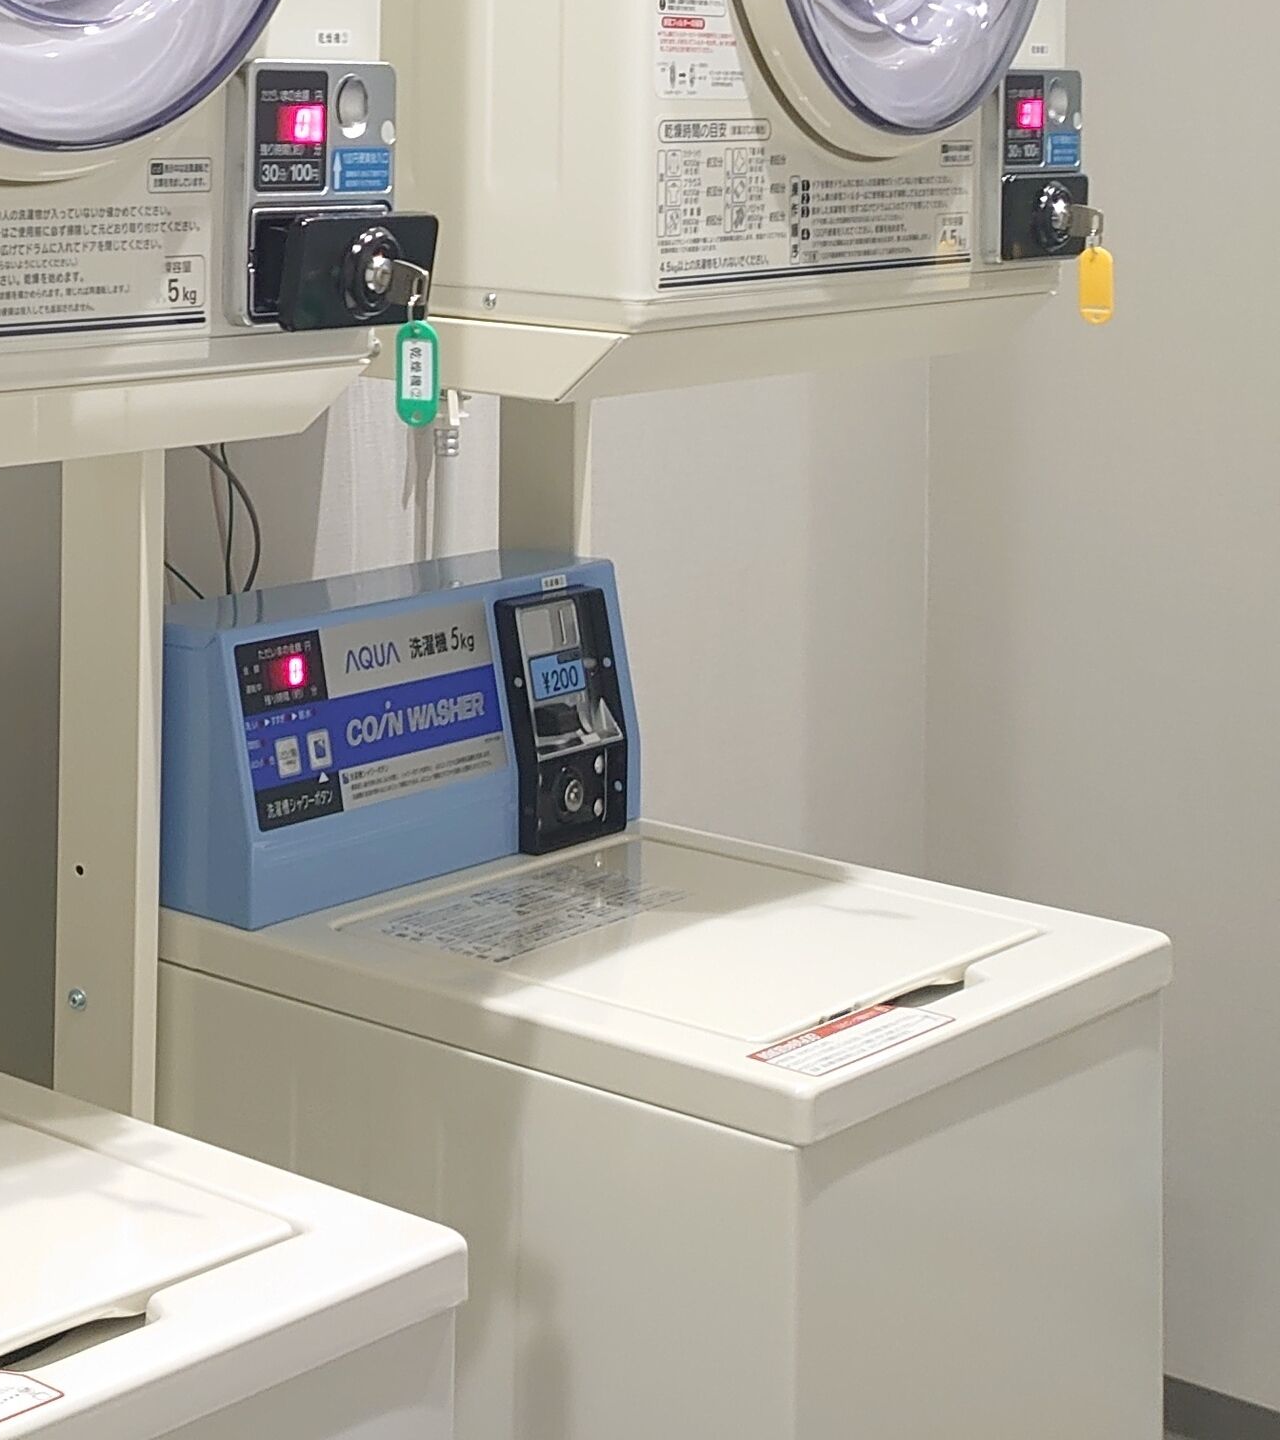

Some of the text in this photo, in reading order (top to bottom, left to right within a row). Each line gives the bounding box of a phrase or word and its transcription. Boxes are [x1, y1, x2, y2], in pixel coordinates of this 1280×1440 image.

[345, 640, 401, 674] AQUA
[408, 626, 475, 660] 洗濯機 5kg
[541, 665, 579, 694] ¥200
[406, 691, 485, 733] WASHER
